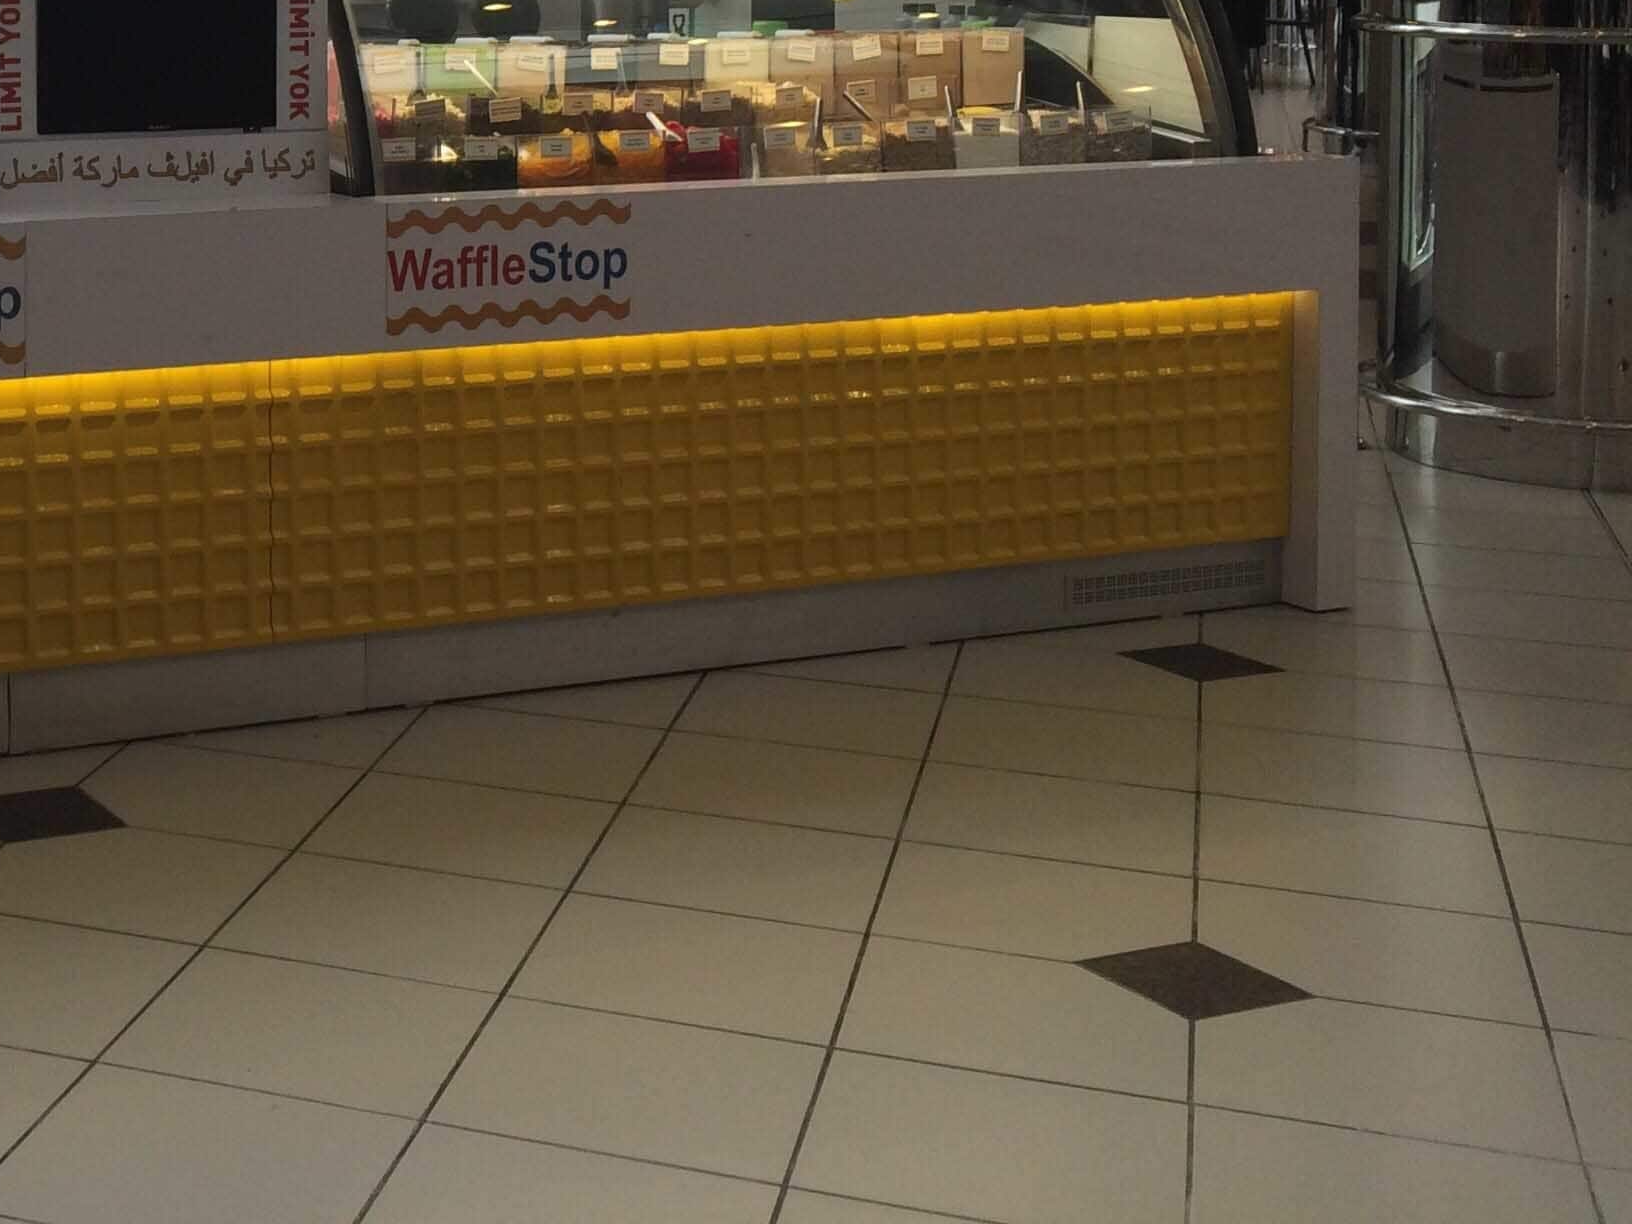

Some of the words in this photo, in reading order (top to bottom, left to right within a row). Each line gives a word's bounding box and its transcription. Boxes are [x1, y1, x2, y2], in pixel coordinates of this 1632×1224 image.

[289, 63, 311, 120] YOK
[224, 150, 254, 186] في
[260, 147, 316, 179] تركيا
[388, 241, 628, 291] WaffleStop
